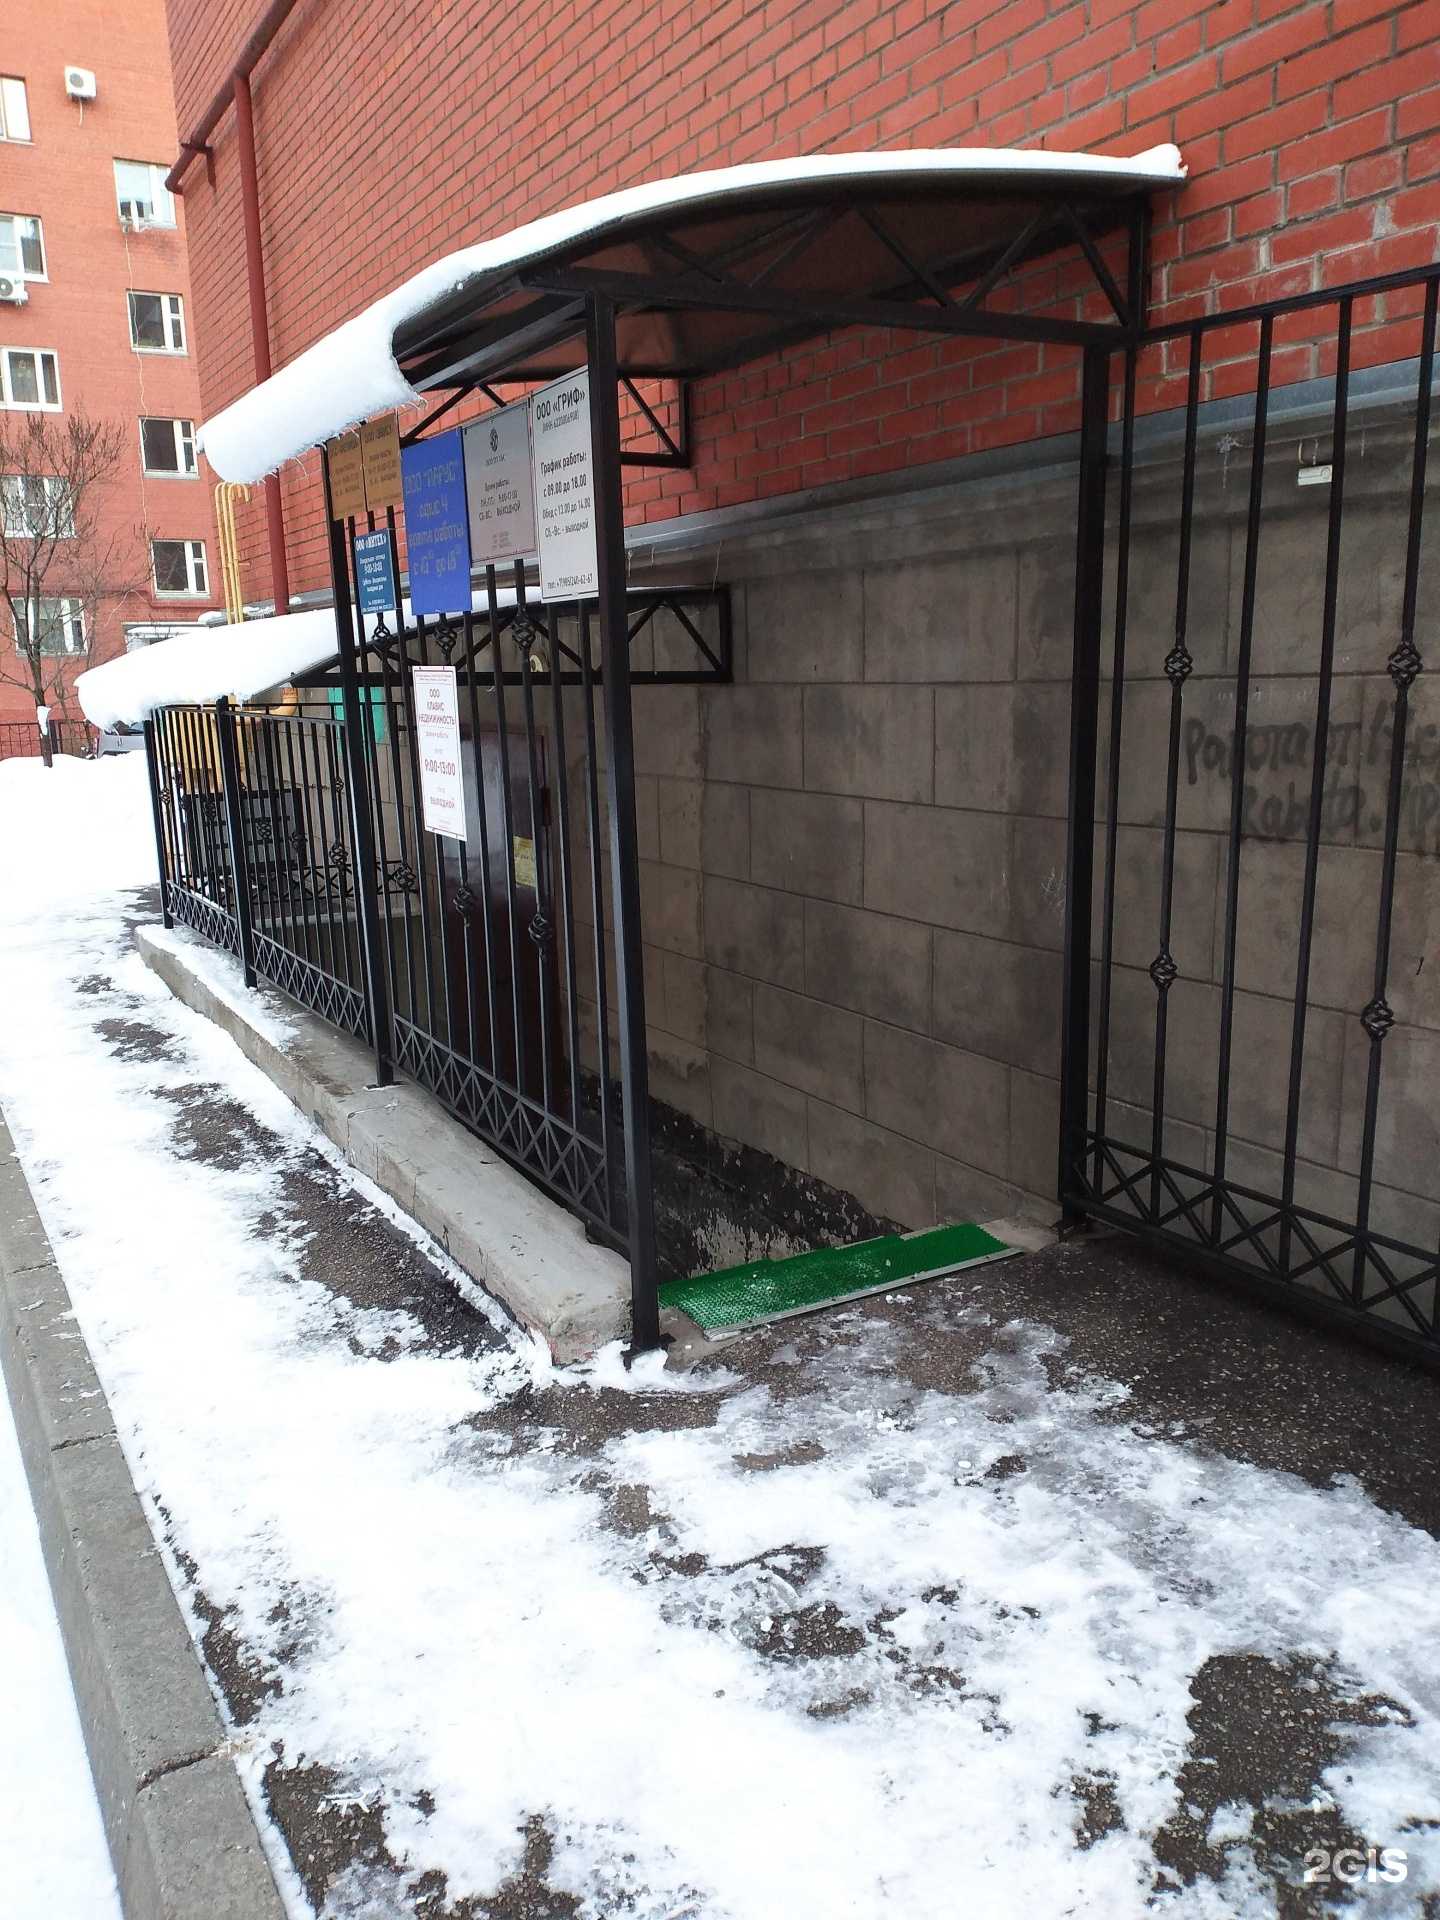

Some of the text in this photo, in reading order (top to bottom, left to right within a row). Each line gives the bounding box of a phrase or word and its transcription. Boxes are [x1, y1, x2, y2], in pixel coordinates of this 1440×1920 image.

[536, 387, 586, 420] ООО «ГРИФ»
[540, 451, 587, 476] График работы:
[547, 481, 562, 496] 09.00
[562, 484, 571, 495] до
[571, 474, 587, 490] 18.00
[570, 504, 577, 515] до
